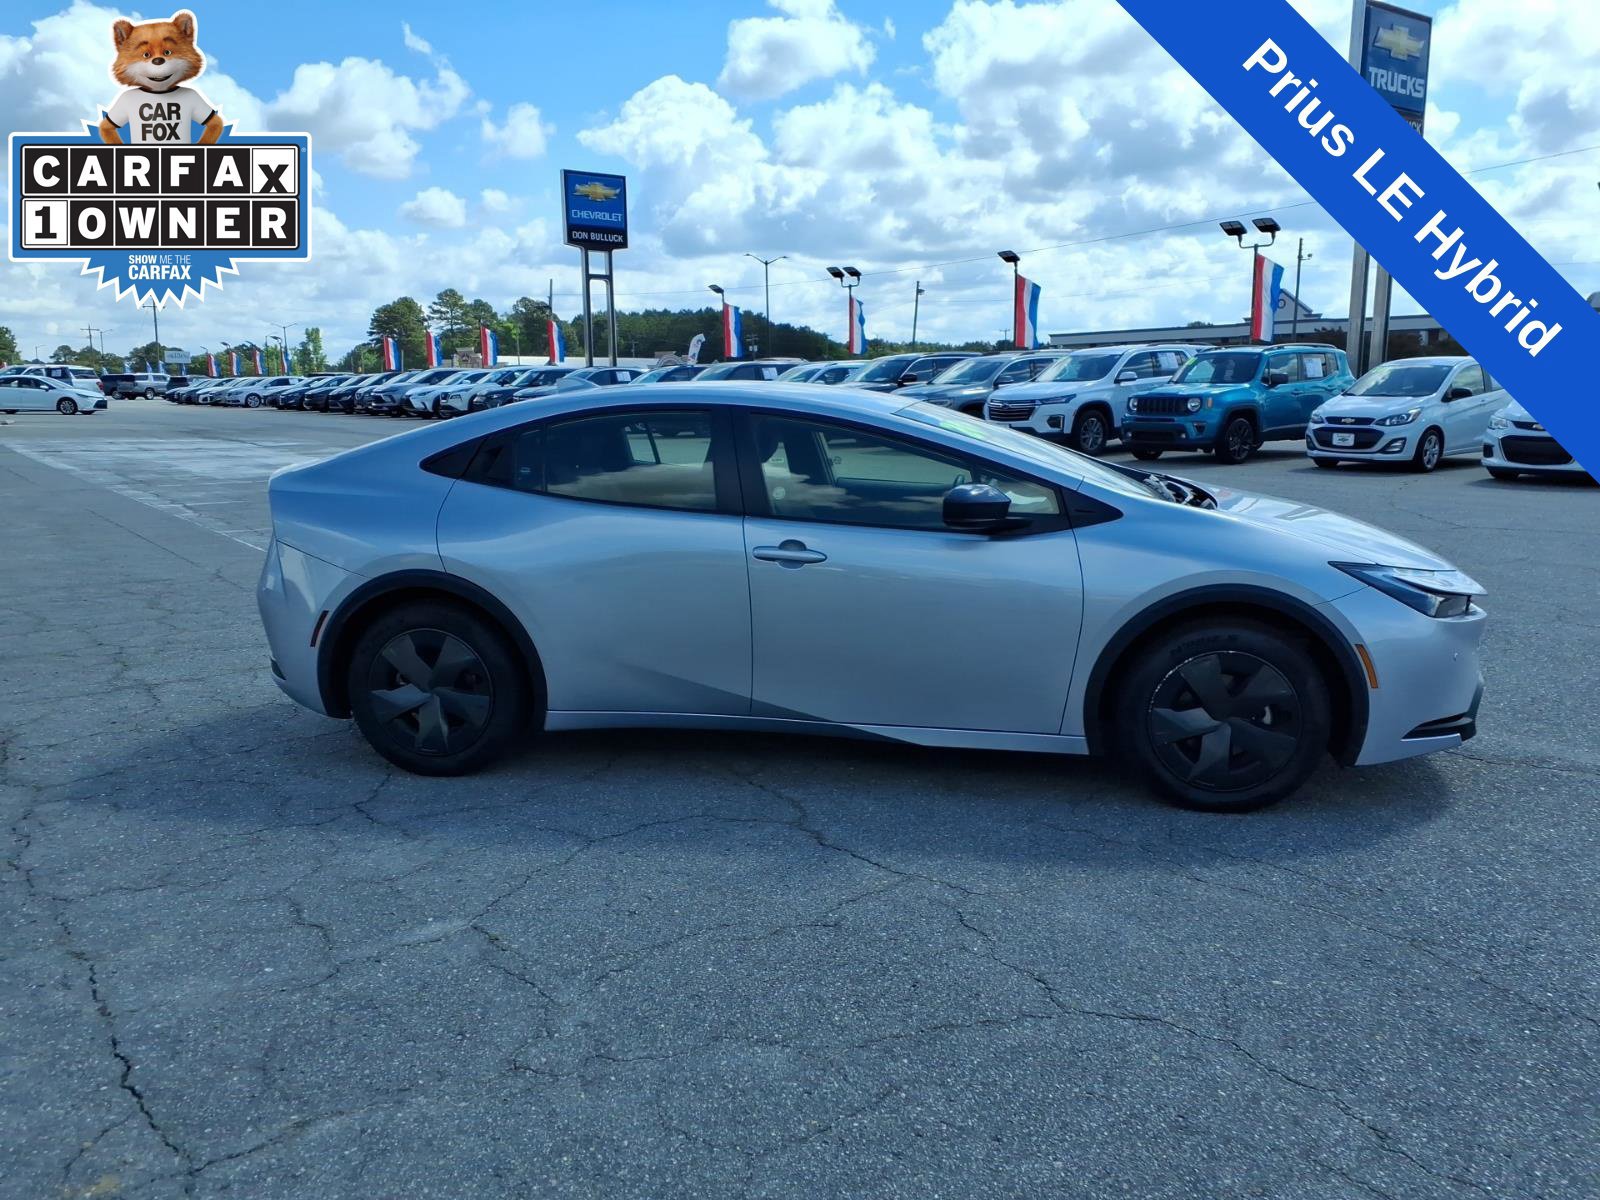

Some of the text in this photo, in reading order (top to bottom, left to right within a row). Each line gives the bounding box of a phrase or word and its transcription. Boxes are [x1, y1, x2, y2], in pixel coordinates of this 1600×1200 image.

[1369, 66, 1425, 98] TRUCKS
[571, 209, 622, 221] CHEVROLET
[572, 231, 624, 243] DON BULLUCK
